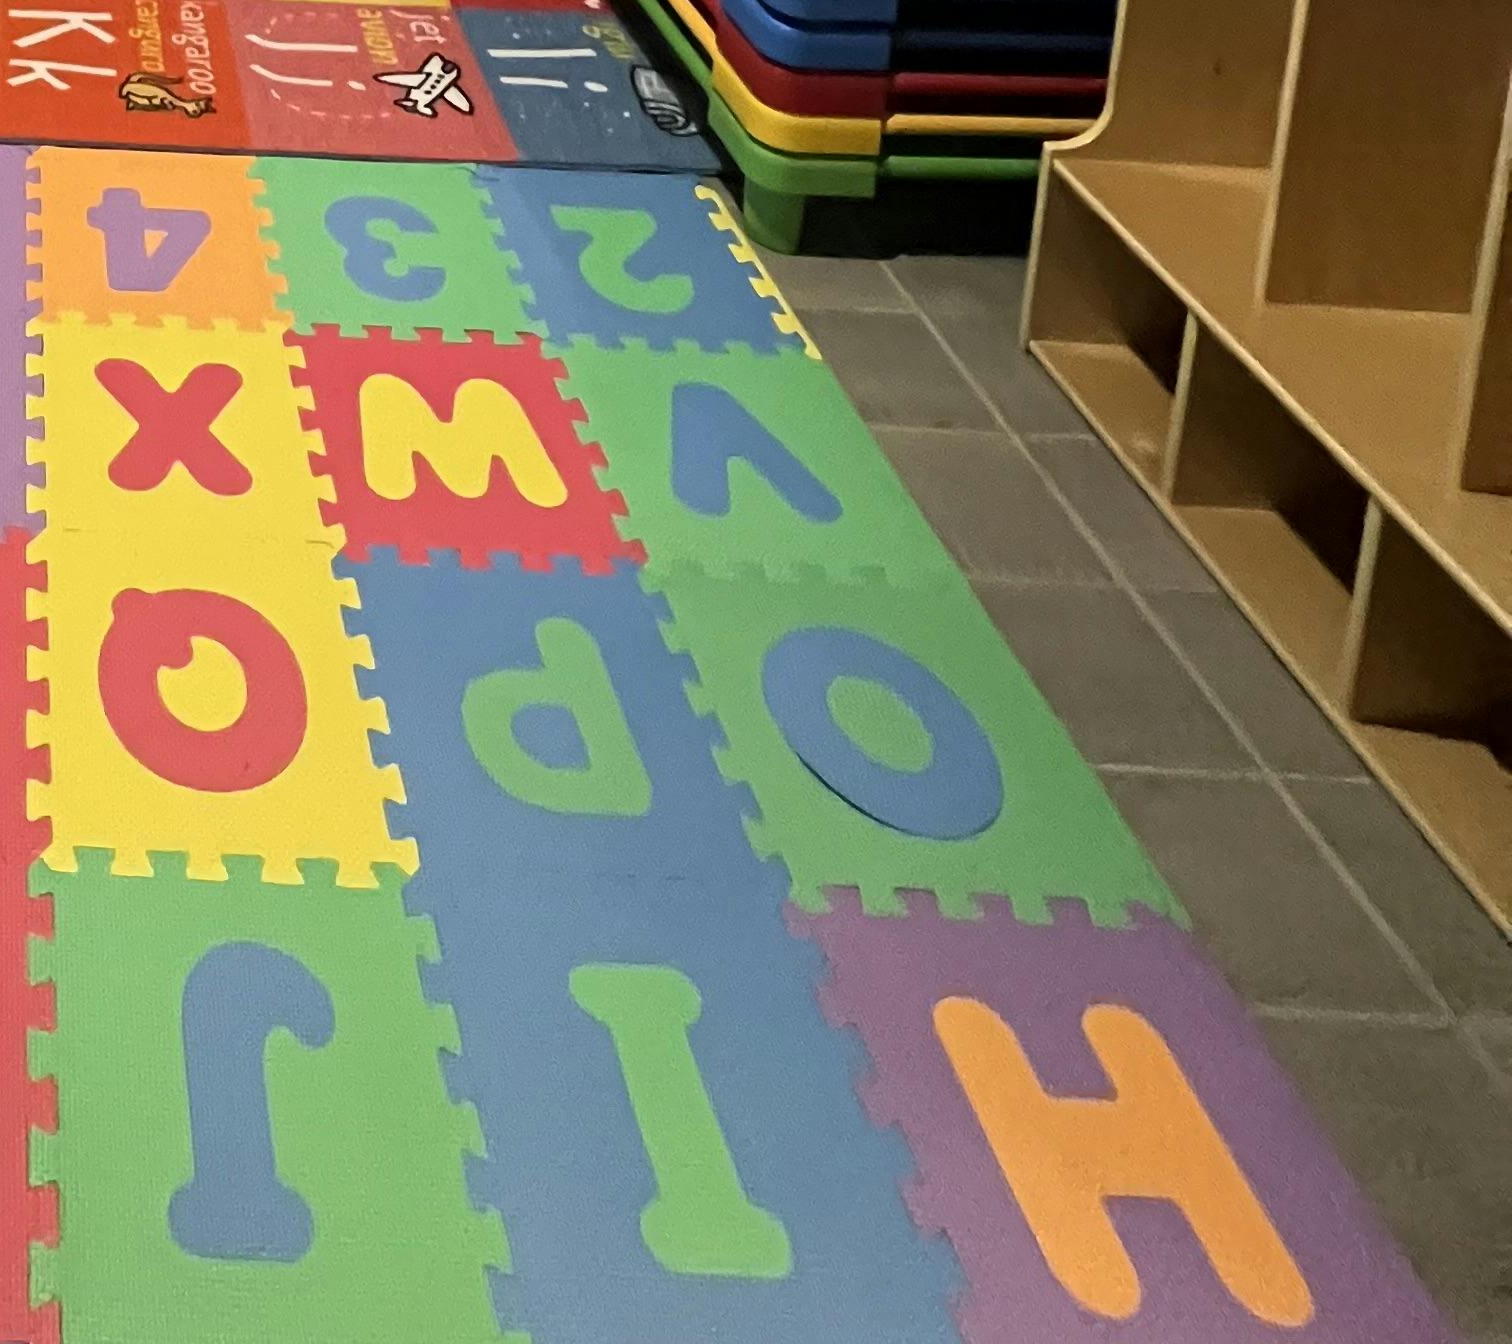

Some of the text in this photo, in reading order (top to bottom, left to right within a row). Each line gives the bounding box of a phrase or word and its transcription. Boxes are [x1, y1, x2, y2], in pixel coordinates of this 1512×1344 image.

[7, 7, 118, 91] Kk
[127, 0, 161, 73] canguro
[391, 8, 445, 46] jet
[85, 186, 212, 293] 4
[322, 194, 448, 302] 3
[551, 205, 695, 313] 2
[94, 357, 254, 496] X
[357, 373, 571, 509] W
[670, 381, 845, 523] V
[96, 587, 310, 793] Q
[460, 617, 653, 817] P
[761, 625, 1006, 841] O
[165, 940, 337, 1265] J
[568, 962, 794, 1279] I
[932, 995, 1316, 1328] H
